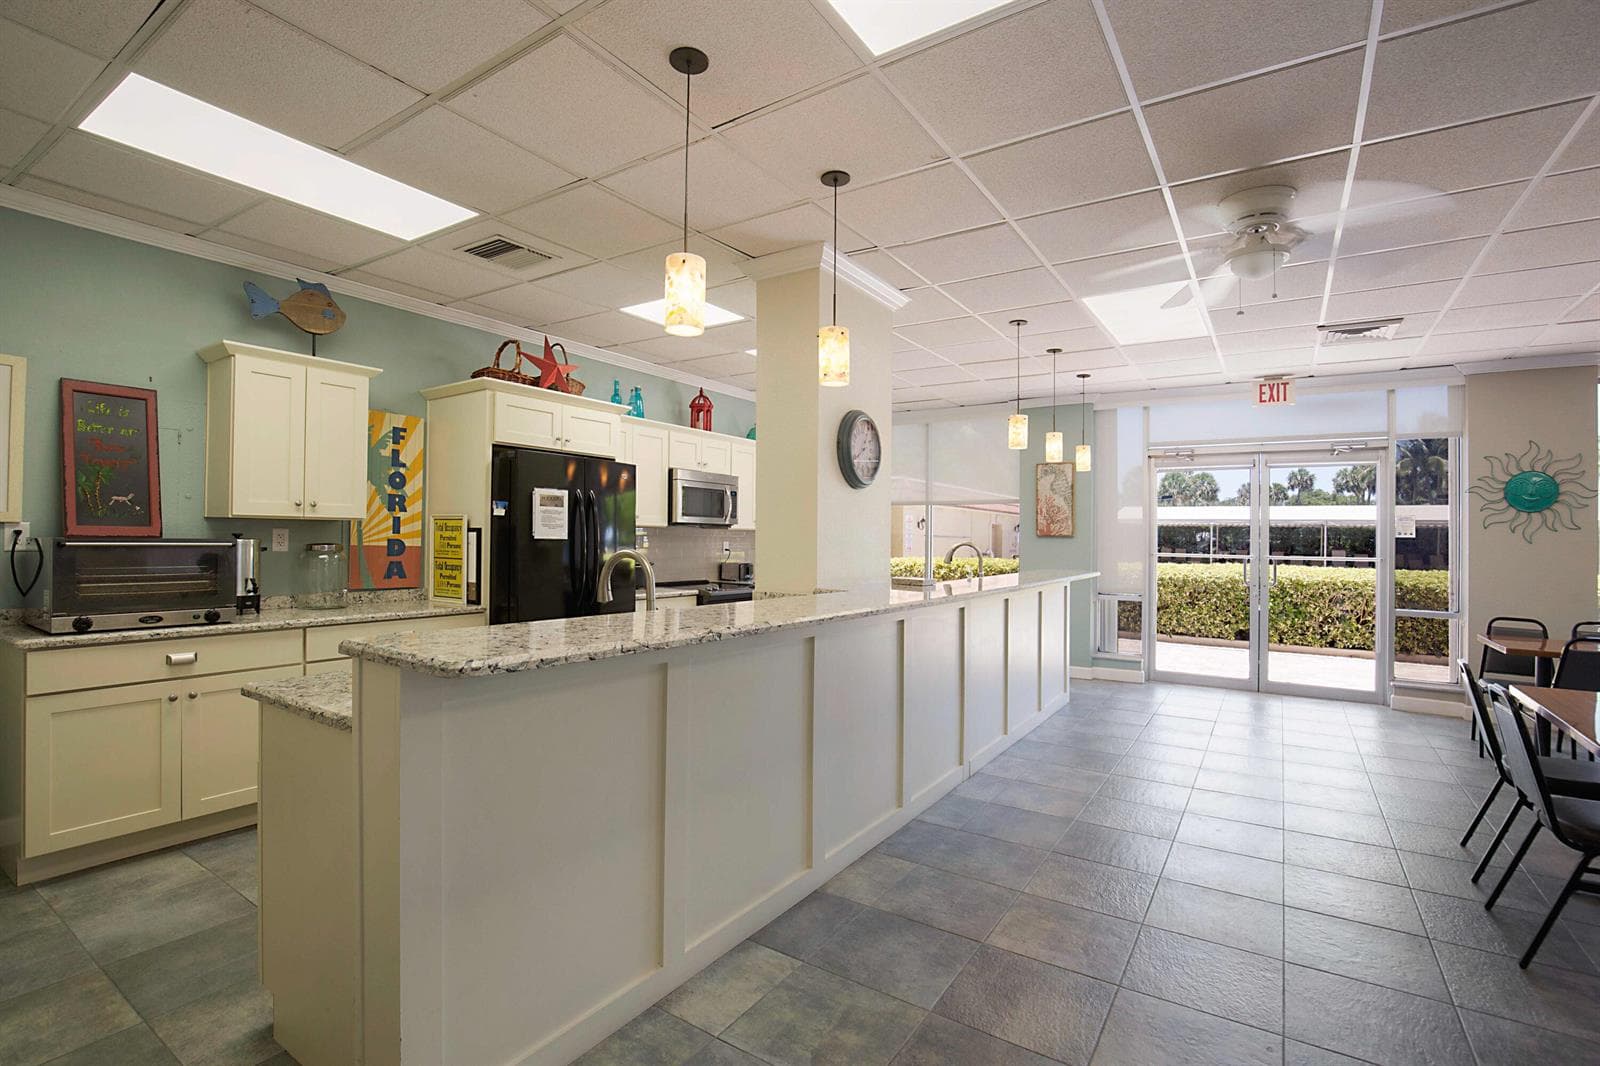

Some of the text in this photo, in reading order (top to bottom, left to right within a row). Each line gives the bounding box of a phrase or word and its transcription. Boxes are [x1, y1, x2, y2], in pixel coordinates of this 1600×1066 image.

[1259, 382, 1289, 402] EXIT
[383, 426, 407, 579] FLORIDA
[445, 522, 462, 536] Occupancy
[445, 561, 462, 575] Occupancy
